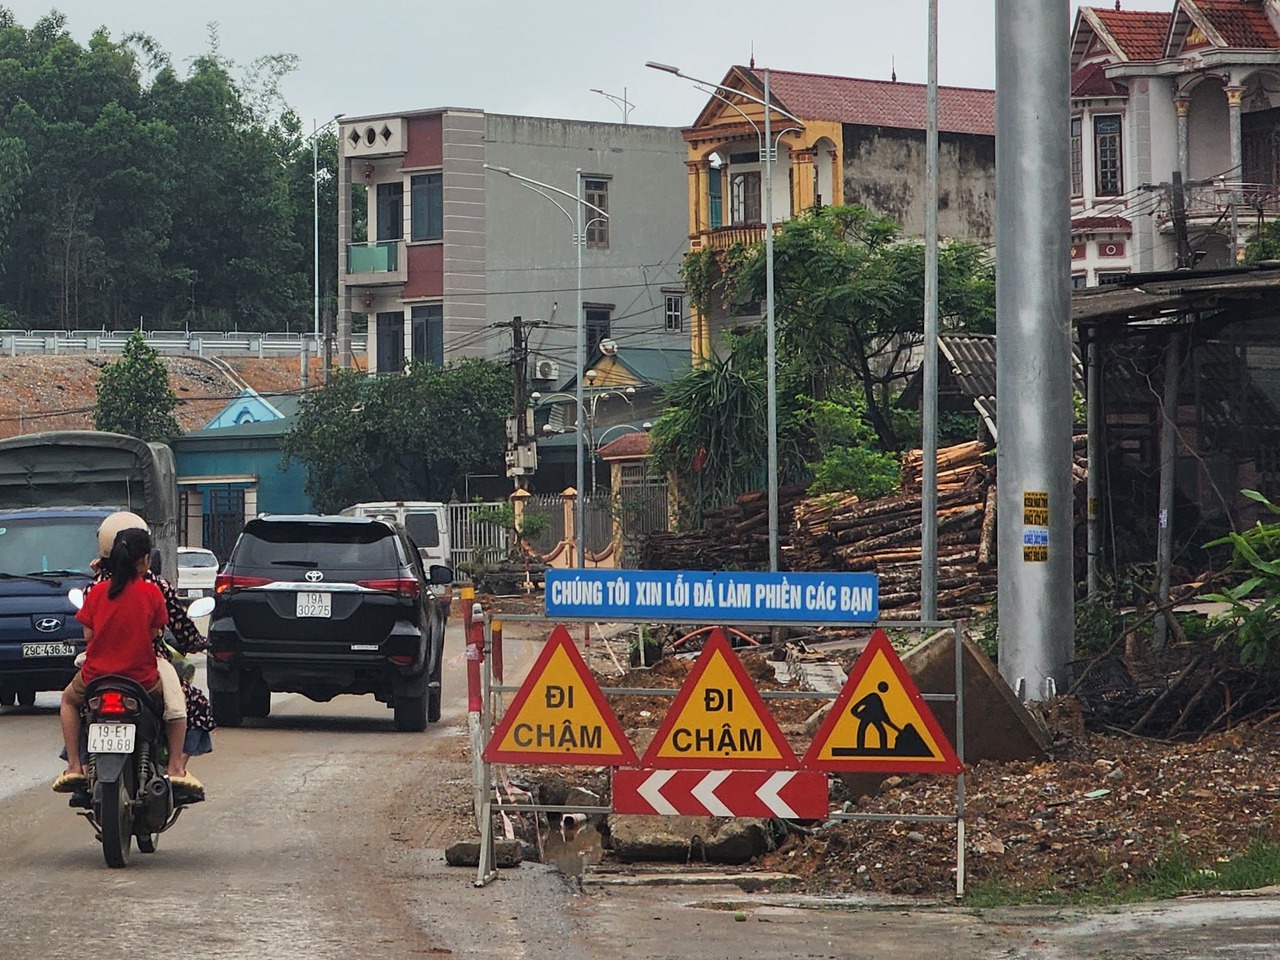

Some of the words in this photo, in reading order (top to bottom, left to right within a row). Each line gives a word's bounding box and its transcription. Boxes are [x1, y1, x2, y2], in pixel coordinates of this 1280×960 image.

[306, 593, 323, 604] 19A
[551, 576, 603, 606] CHÚNG
[606, 576, 630, 606] TÔI
[635, 581, 662, 607] XIN
[666, 573, 689, 608] LỖI
[694, 580, 715, 608] ĐÃ
[718, 580, 751, 609] LÀM
[755, 576, 801, 610] PHIỀN
[805, 582, 837, 611] CÁC
[840, 587, 873, 615] BẠN
[545, 685, 574, 708] ĐI
[704, 688, 733, 712] ĐI
[99, 726, 127, 737] 19-E1
[513, 719, 602, 752] CHẬM
[672, 723, 762, 756] CHẬM
[92, 739, 131, 751] 419.68
